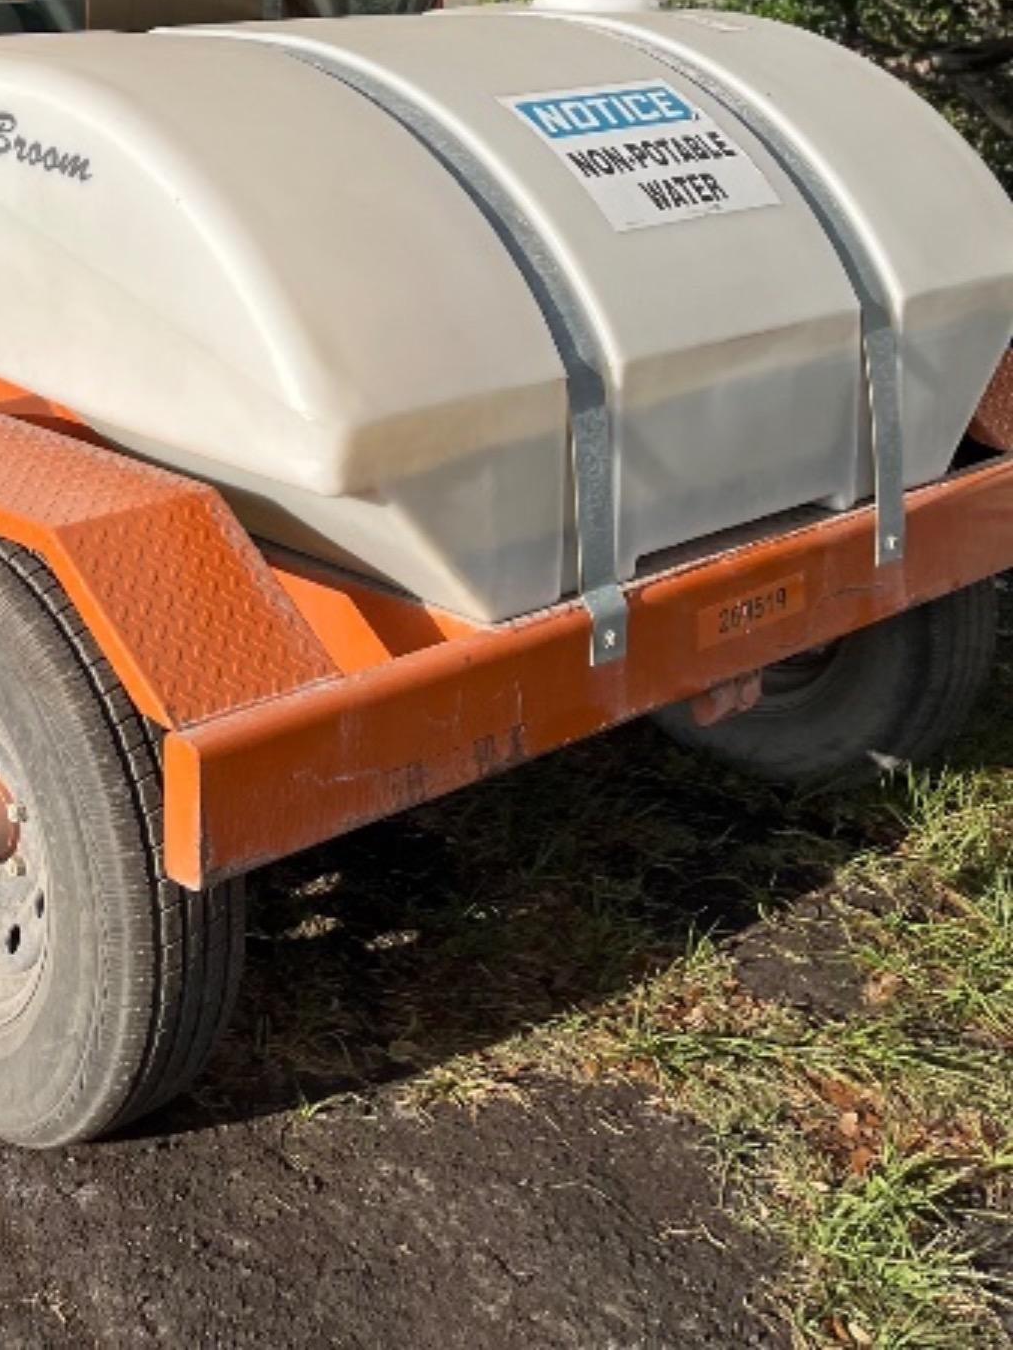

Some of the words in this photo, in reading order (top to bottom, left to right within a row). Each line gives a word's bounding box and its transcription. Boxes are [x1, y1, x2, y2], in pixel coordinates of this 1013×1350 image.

[533, 89, 684, 134] NOTICE
[566, 131, 738, 178] NON-POTABLE
[638, 172, 729, 211] WATER
